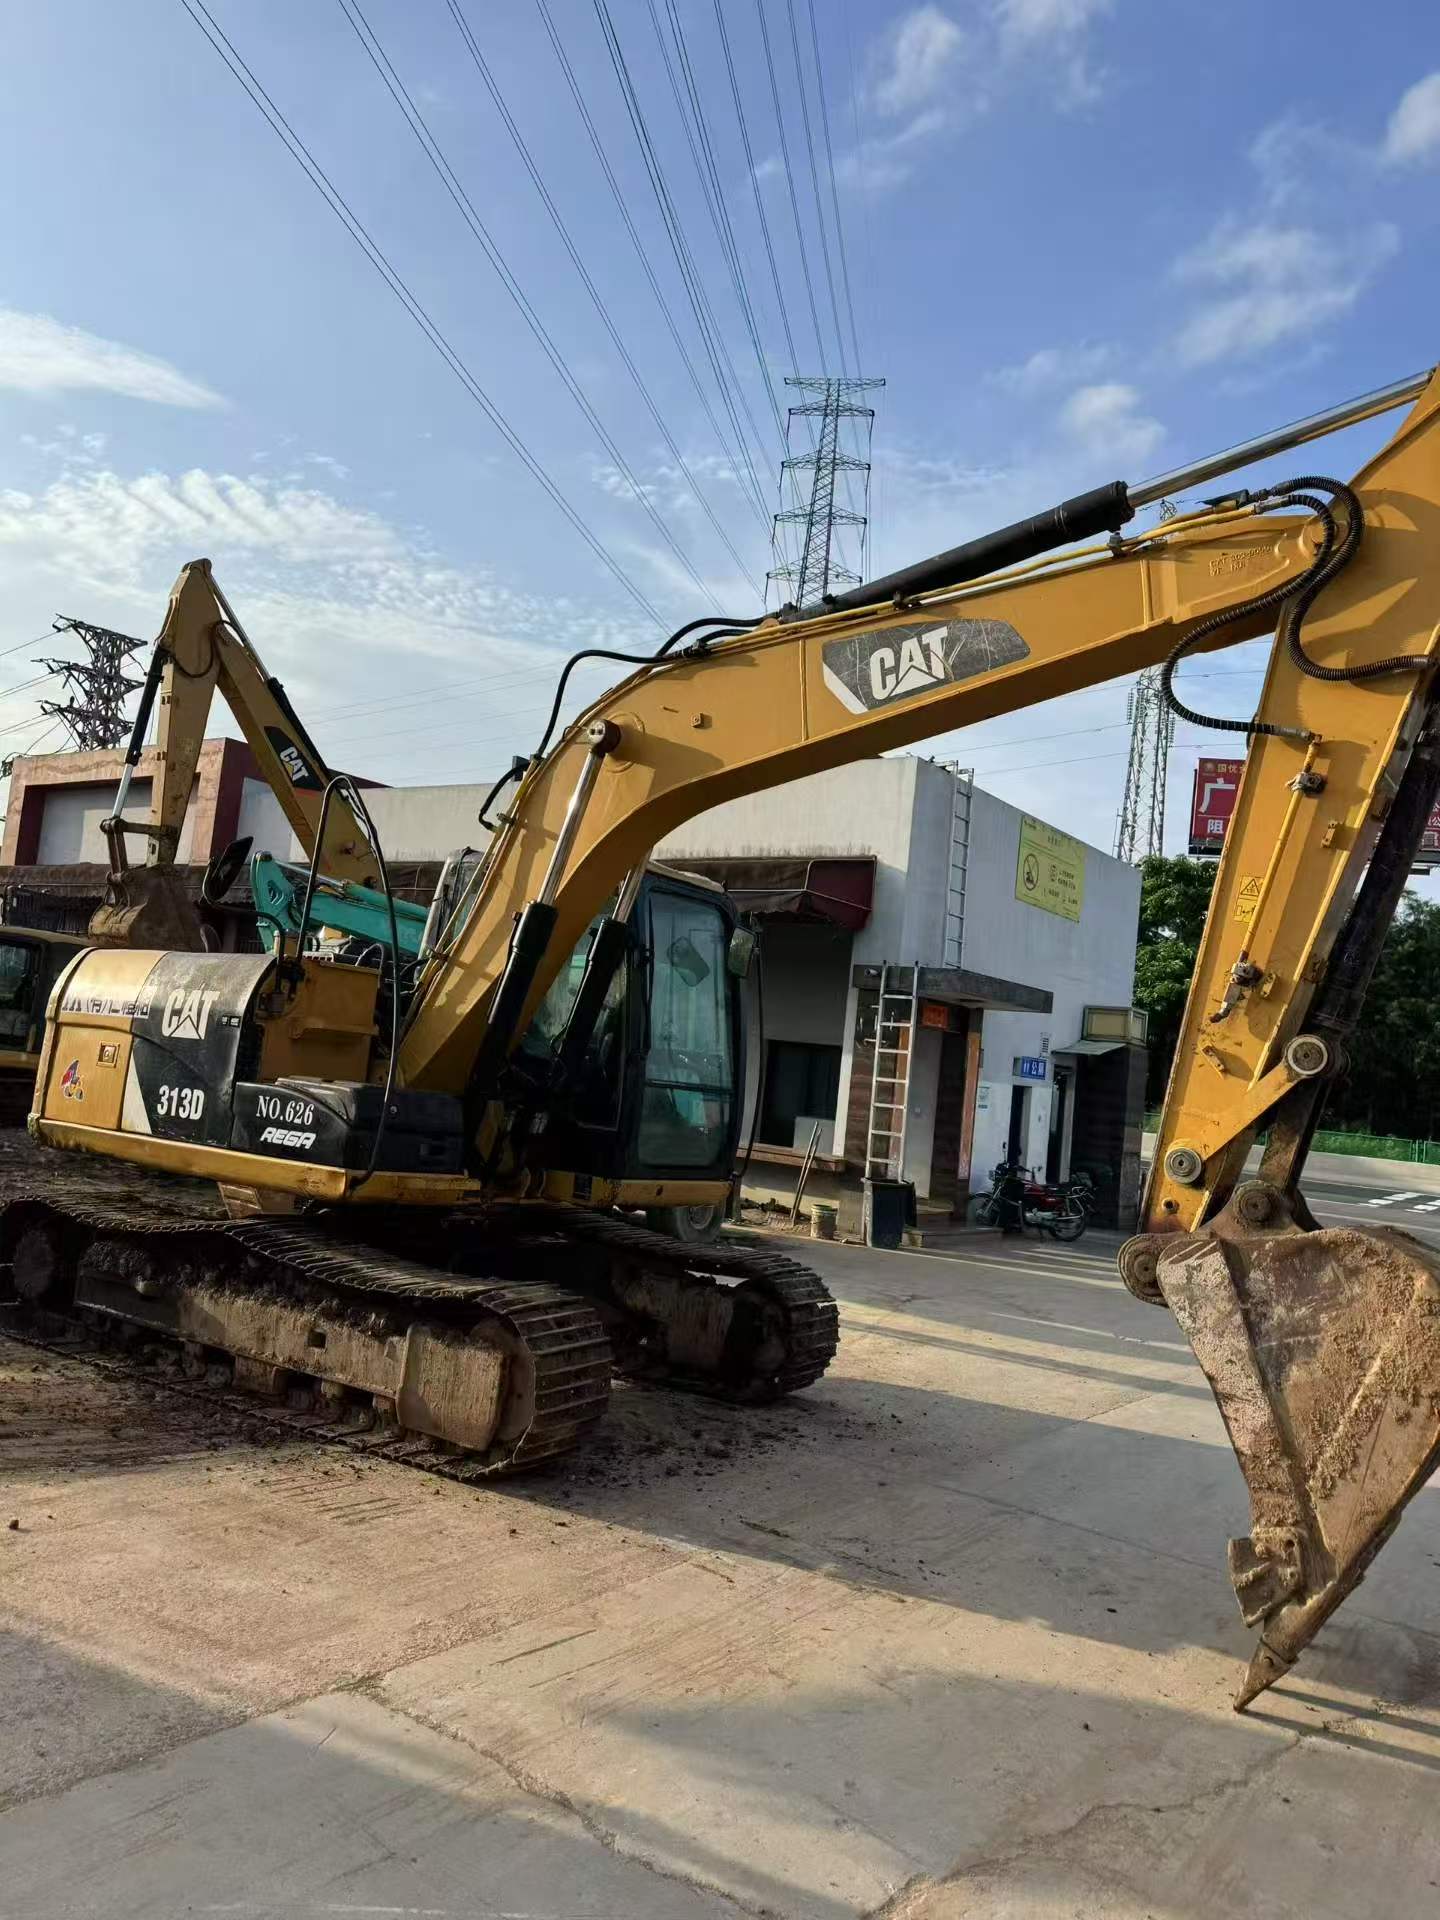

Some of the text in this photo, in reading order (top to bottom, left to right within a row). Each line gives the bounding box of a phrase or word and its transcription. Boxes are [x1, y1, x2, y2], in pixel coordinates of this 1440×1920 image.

[870, 626, 949, 700] CAT
[279, 746, 309, 781] CAT
[162, 988, 220, 1039] CAT
[157, 1085, 205, 1121] 313D
[255, 1095, 316, 1126] NO.626
[260, 1126, 317, 1150] REGA
